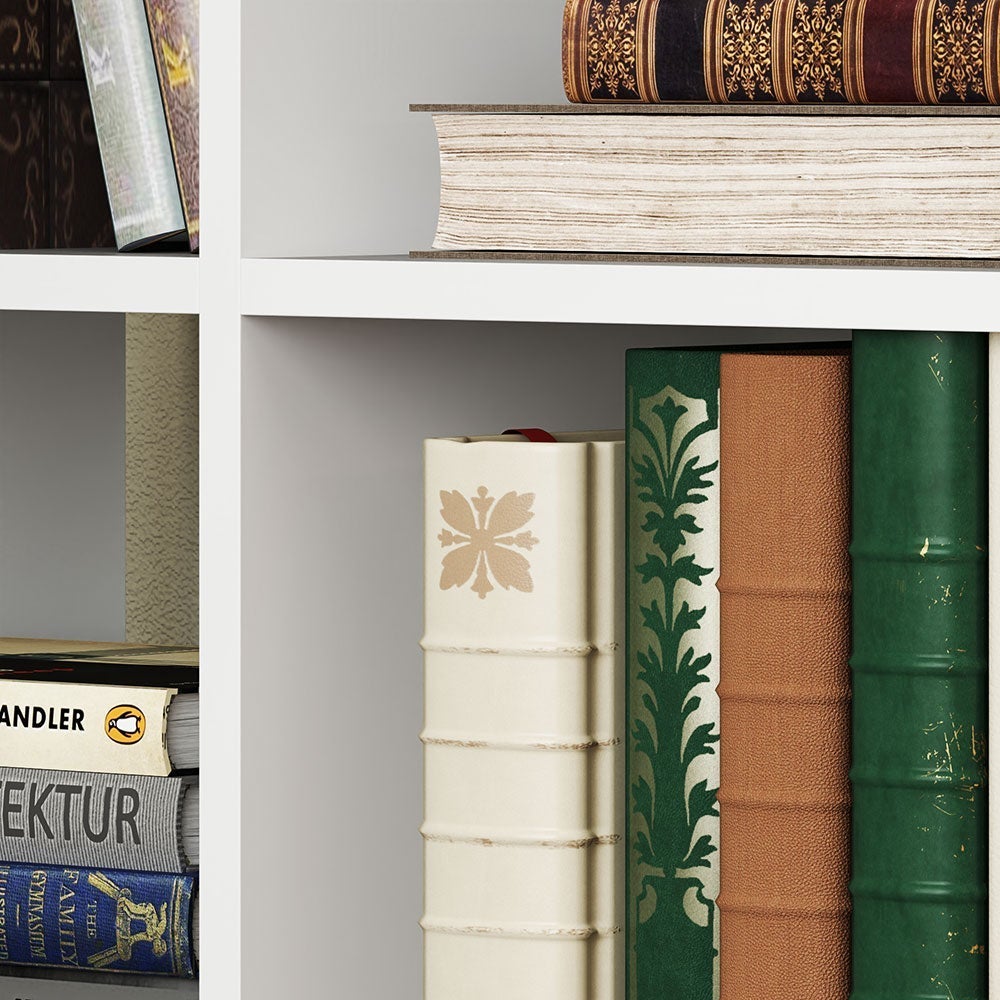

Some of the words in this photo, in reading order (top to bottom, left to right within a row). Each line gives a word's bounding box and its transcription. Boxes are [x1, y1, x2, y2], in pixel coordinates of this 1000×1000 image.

[0, 704, 86, 732] ANDLER
[2, 781, 141, 845] EKTUR
[28, 870, 47, 960] GYMNASIUM
[59, 869, 79, 966] FAMILY
[86, 900, 98, 939] THE
